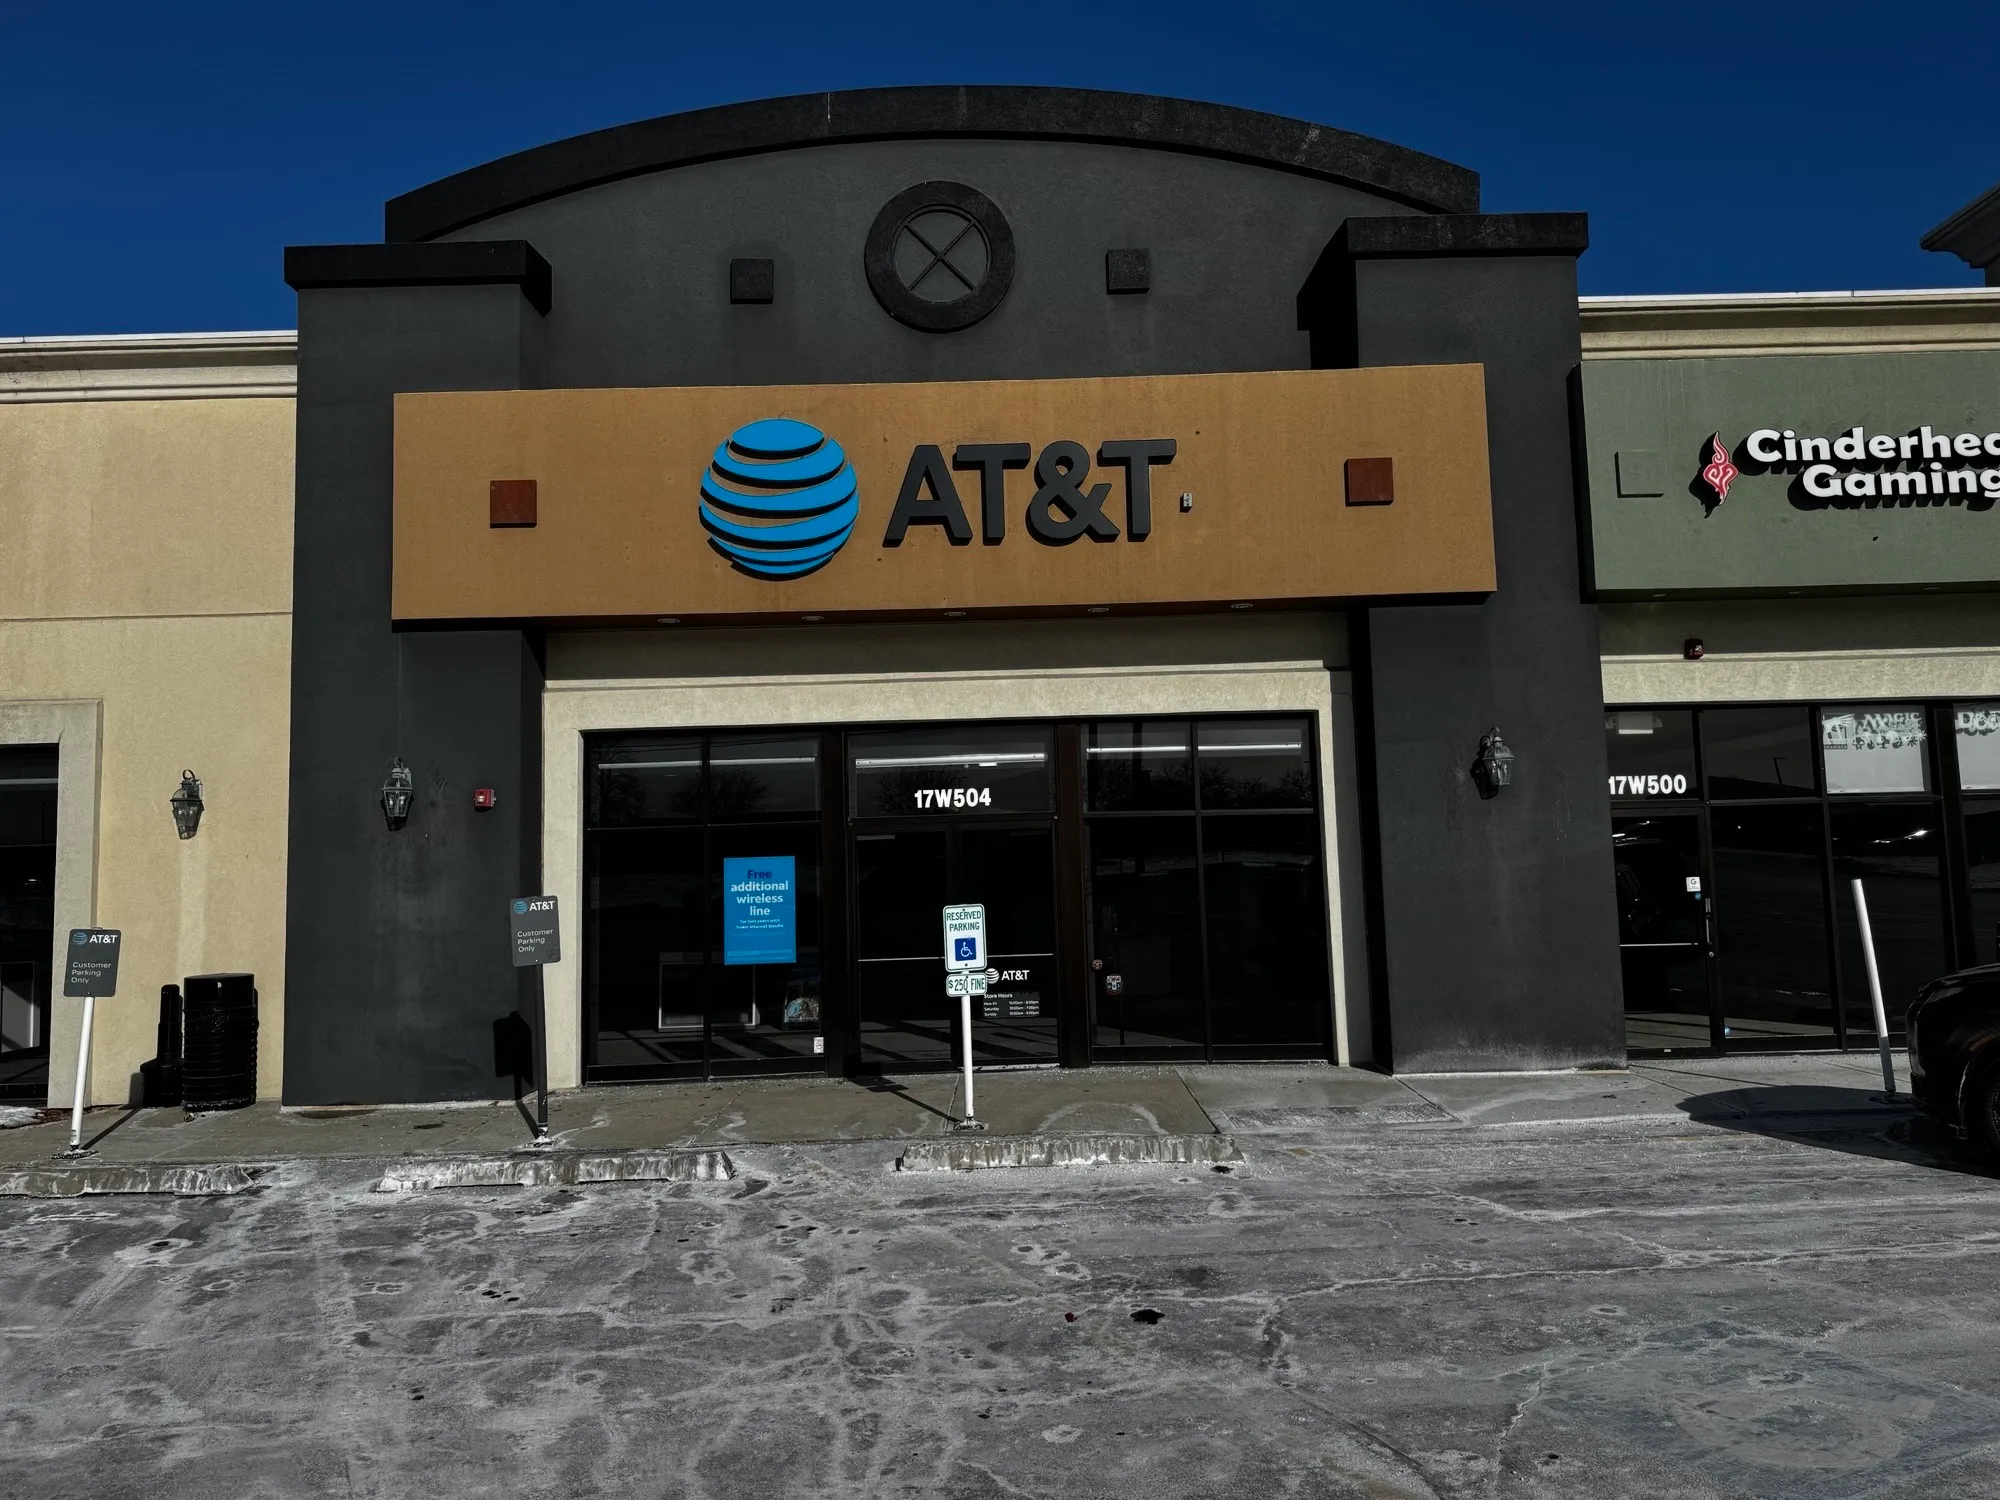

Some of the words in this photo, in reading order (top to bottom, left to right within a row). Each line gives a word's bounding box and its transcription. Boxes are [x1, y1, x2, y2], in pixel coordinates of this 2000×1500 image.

[1802, 462, 2000, 499] Gaming
[882, 438, 1177, 547] AT&T
[1608, 774, 1687, 795] 17W500
[914, 787, 992, 809] 17W504
[747, 869, 772, 879] Free
[730, 880, 789, 892] additional
[736, 893, 784, 904] wireless
[529, 900, 555, 912] AT&T
[749, 905, 771, 916] line
[946, 910, 982, 921] RESERVED
[949, 921, 980, 932] PARKING
[517, 929, 553, 937] Customer
[89, 934, 118, 944] AT&T
[517, 937, 545, 945] Parking
[518, 945, 535, 953] Only
[71, 969, 102, 978] Parking
[1001, 969, 1030, 981] AT&T
[970, 977, 985, 991] FINE
